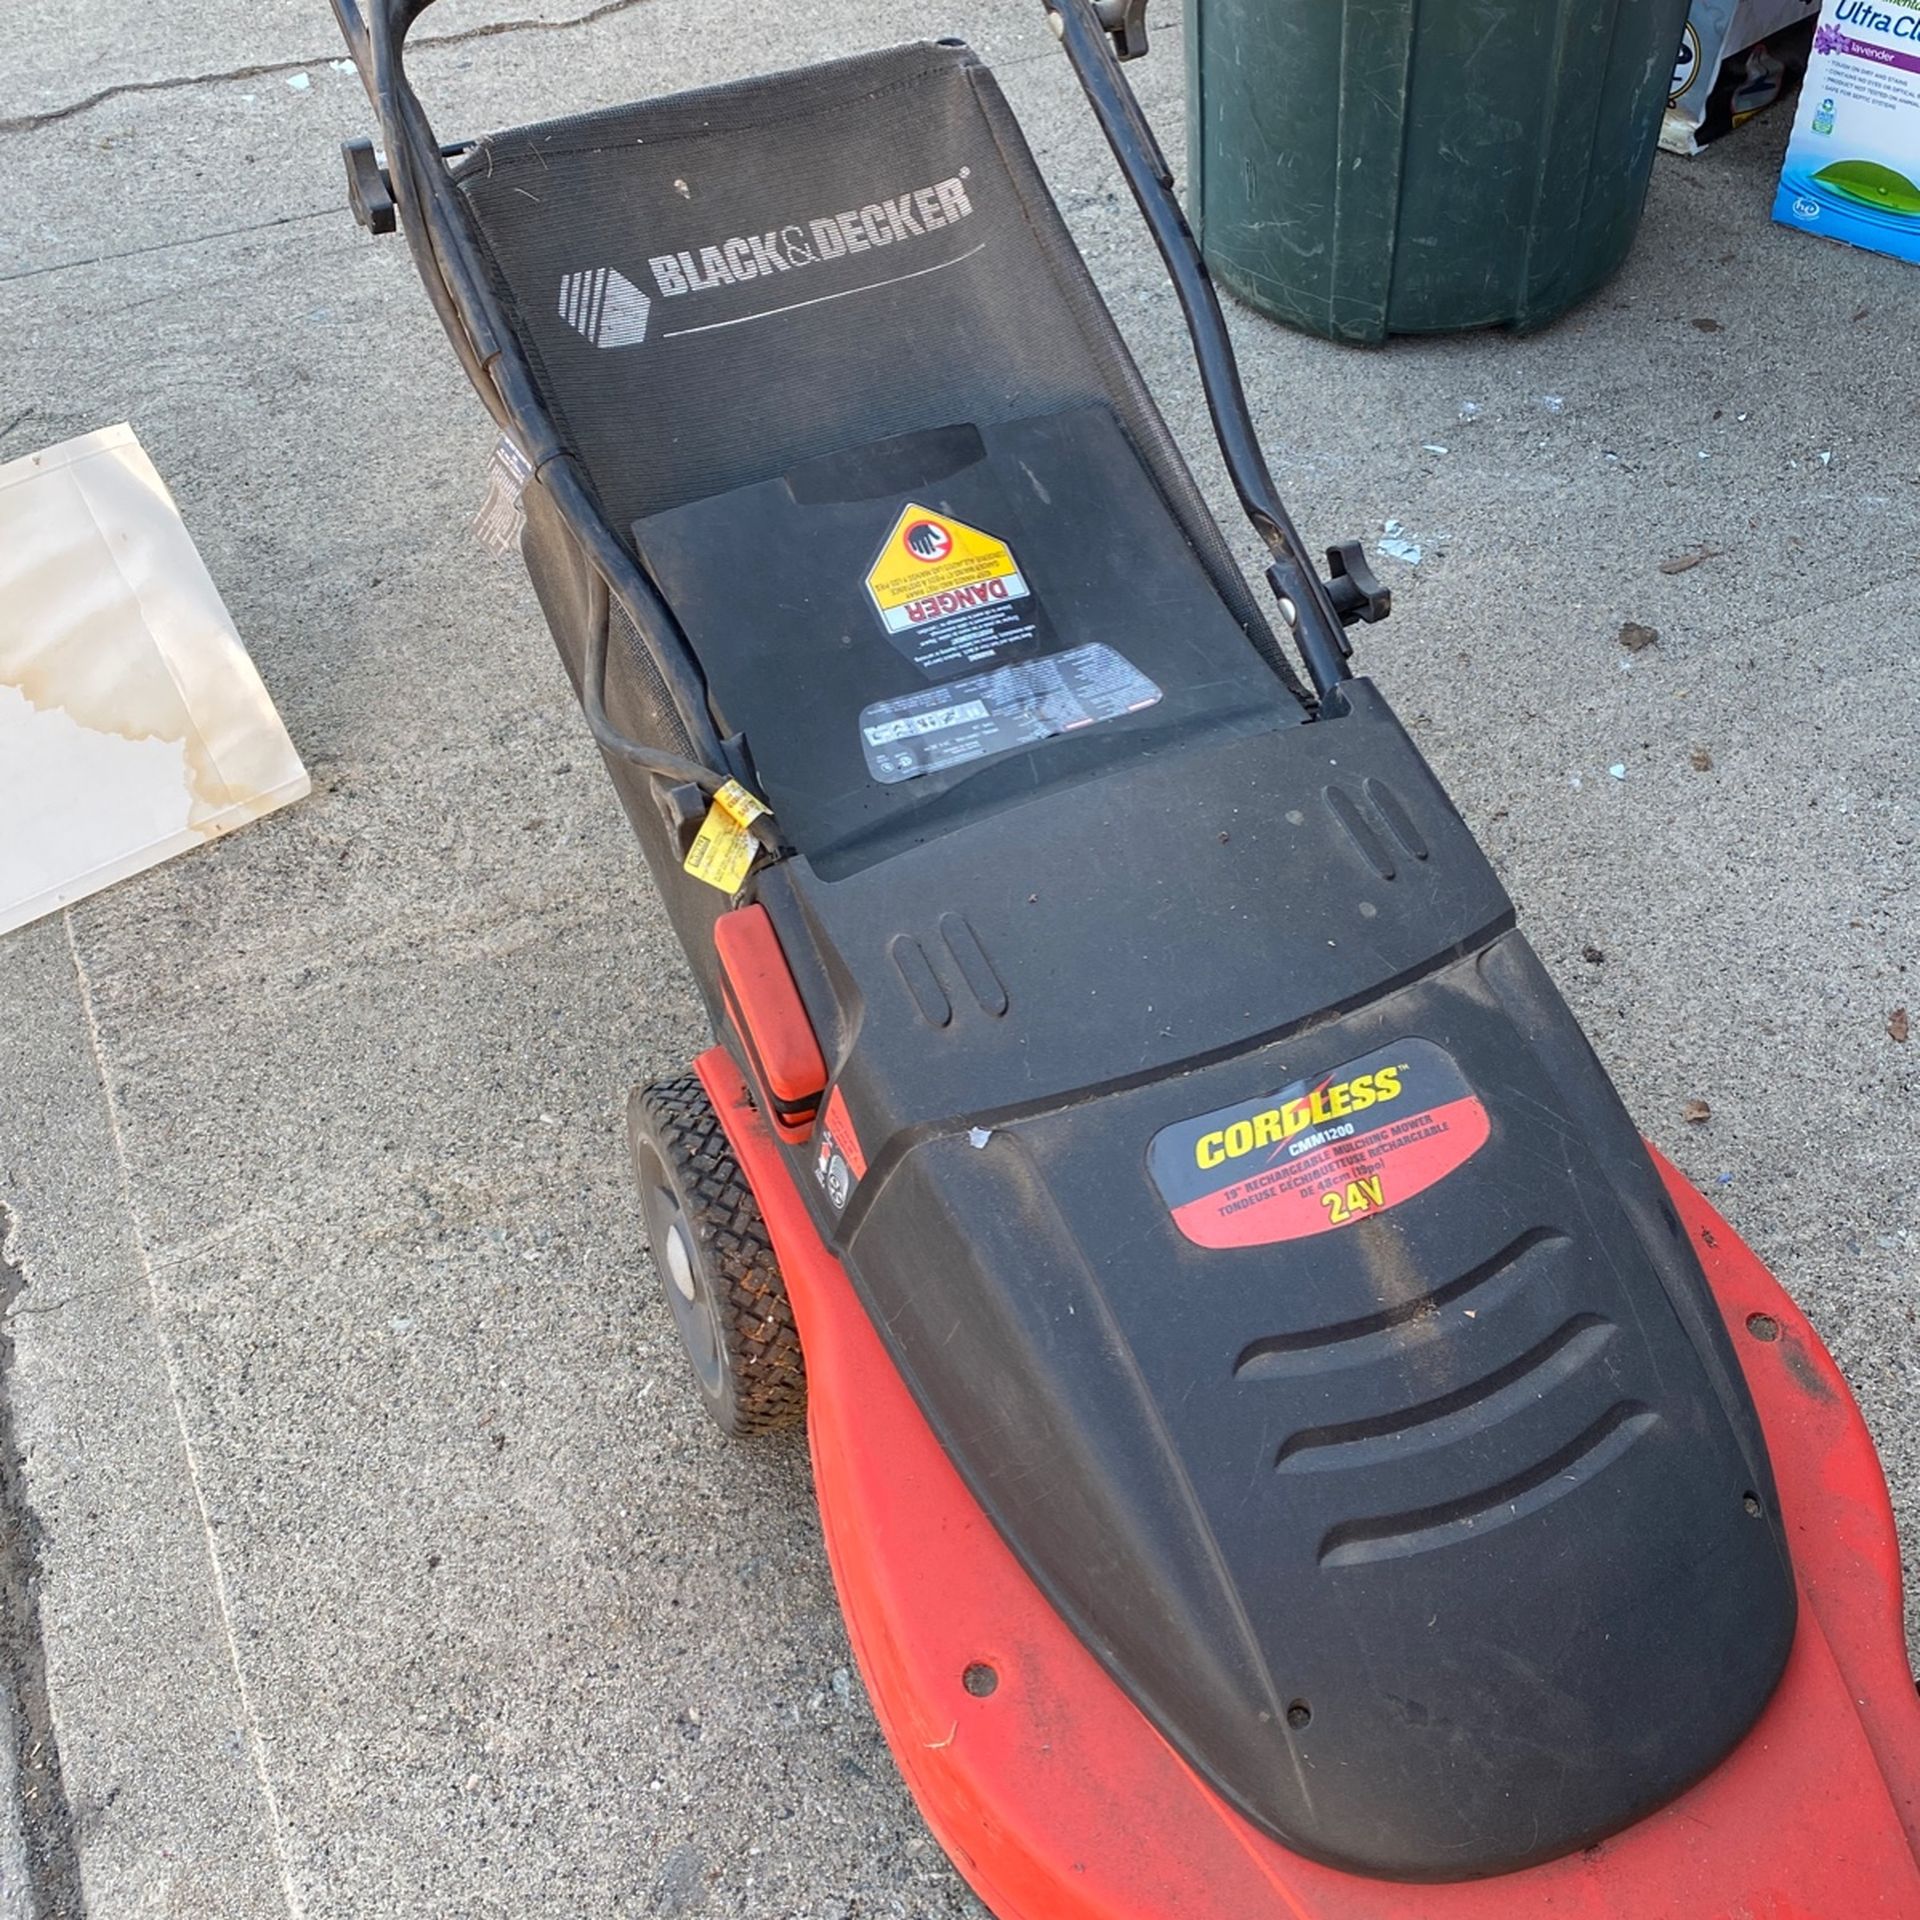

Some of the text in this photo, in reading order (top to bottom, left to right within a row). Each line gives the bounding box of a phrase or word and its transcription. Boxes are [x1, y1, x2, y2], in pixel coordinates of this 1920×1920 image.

[1835, 0, 1920, 42] Ultra Cl
[1851, 42, 1895, 62] lavender
[904, 579, 1008, 624] DANGER
[1195, 1064, 1402, 1170] CORDLESS
[1244, 1150, 1332, 1194] RECHARGEABLE
[1332, 1129, 1389, 1157] MULCHING
[1390, 1115, 1433, 1139] MOWER
[1288, 1122, 1355, 1157] CMM1200
[1217, 1188, 1277, 1217] TONDEUSE
[1300, 1185, 1316, 1200] DE
[1317, 1171, 1351, 1195] 48cm
[1321, 1175, 1384, 1225] 24V
